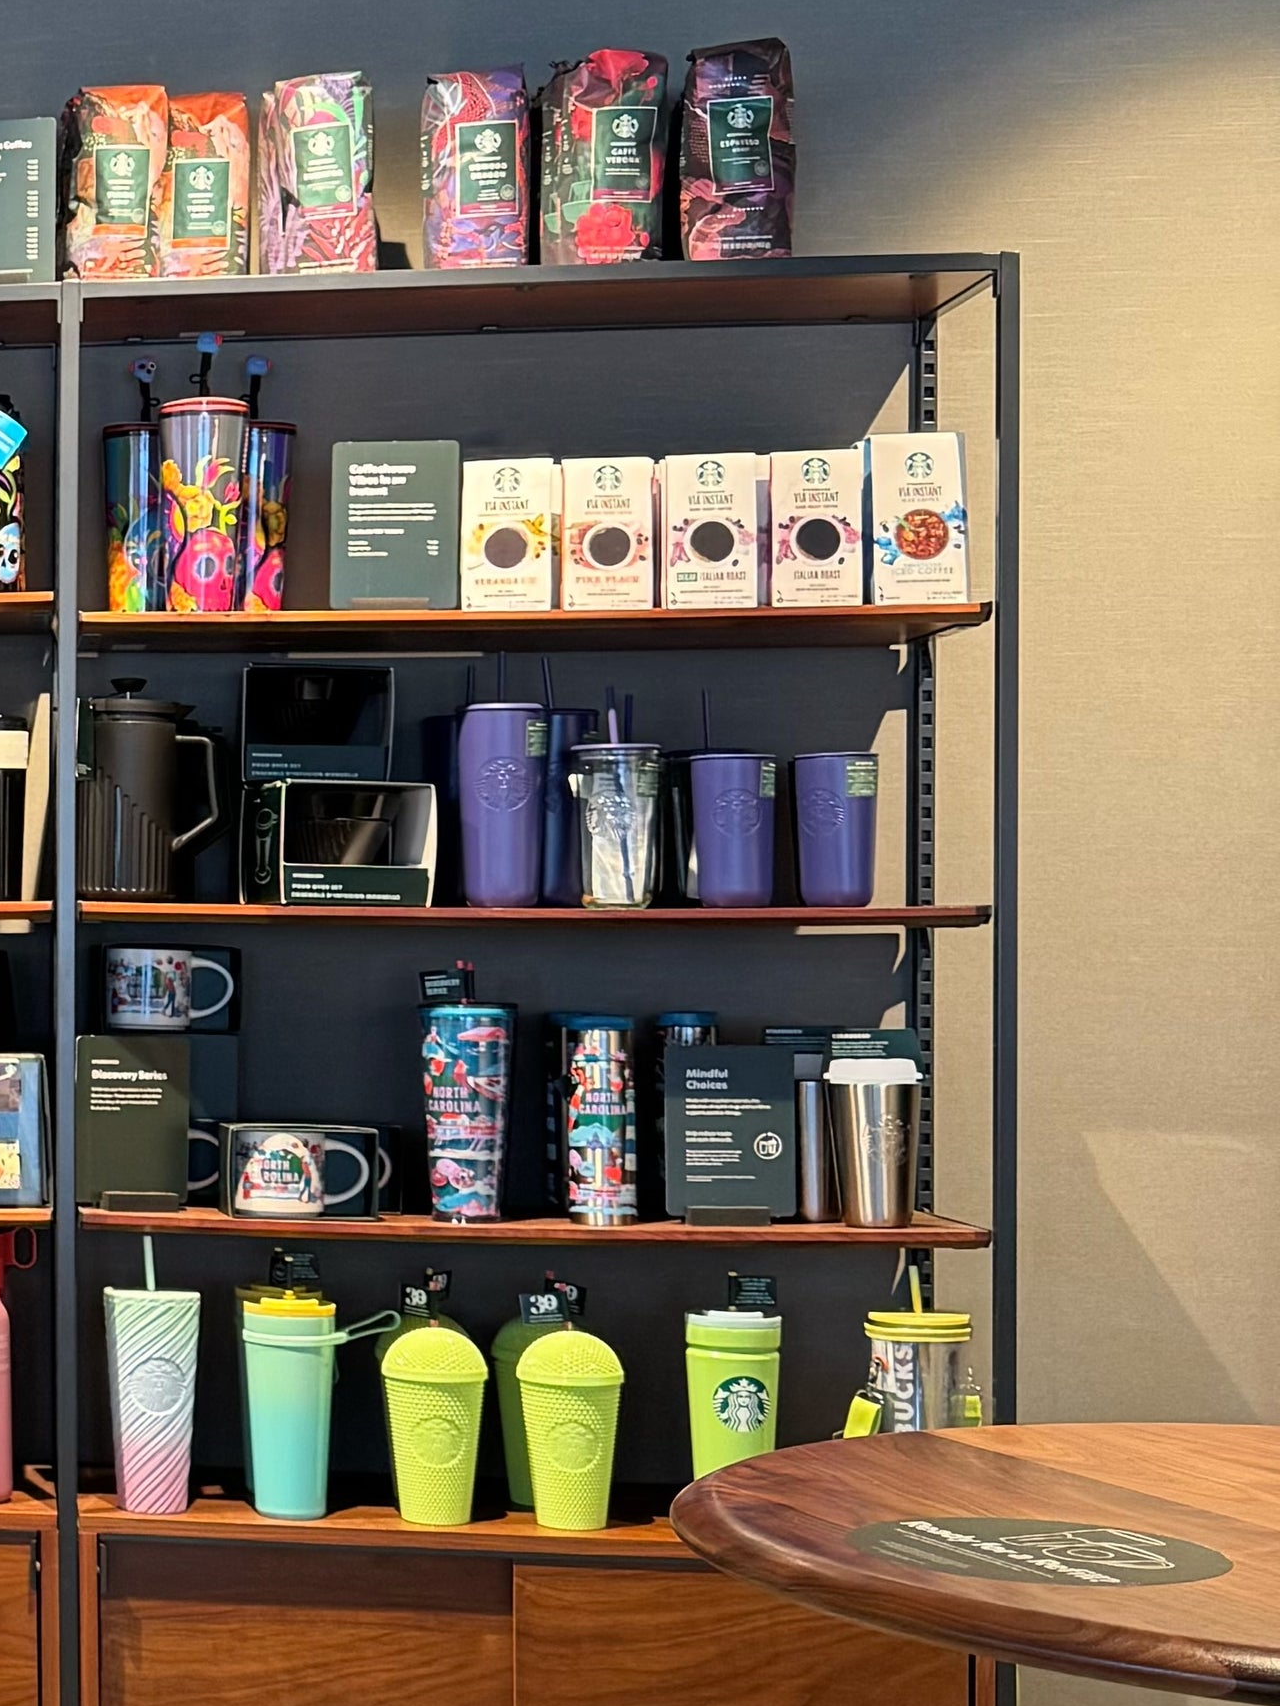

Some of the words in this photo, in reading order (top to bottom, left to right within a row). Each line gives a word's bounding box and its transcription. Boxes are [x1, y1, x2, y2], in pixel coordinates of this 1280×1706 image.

[702, 493, 734, 505] INSTANT
[808, 491, 839, 503] INSTANT
[91, 1069, 137, 1083] Discovery
[138, 1069, 168, 1081] Series
[686, 1068, 729, 1079] Mindful
[686, 1079, 729, 1090] Choices
[432, 1086, 469, 1099] NORTH
[585, 1092, 619, 1103] NORTH
[428, 1100, 482, 1113] CAROLINA
[899, 1519, 979, 1544] Ready
